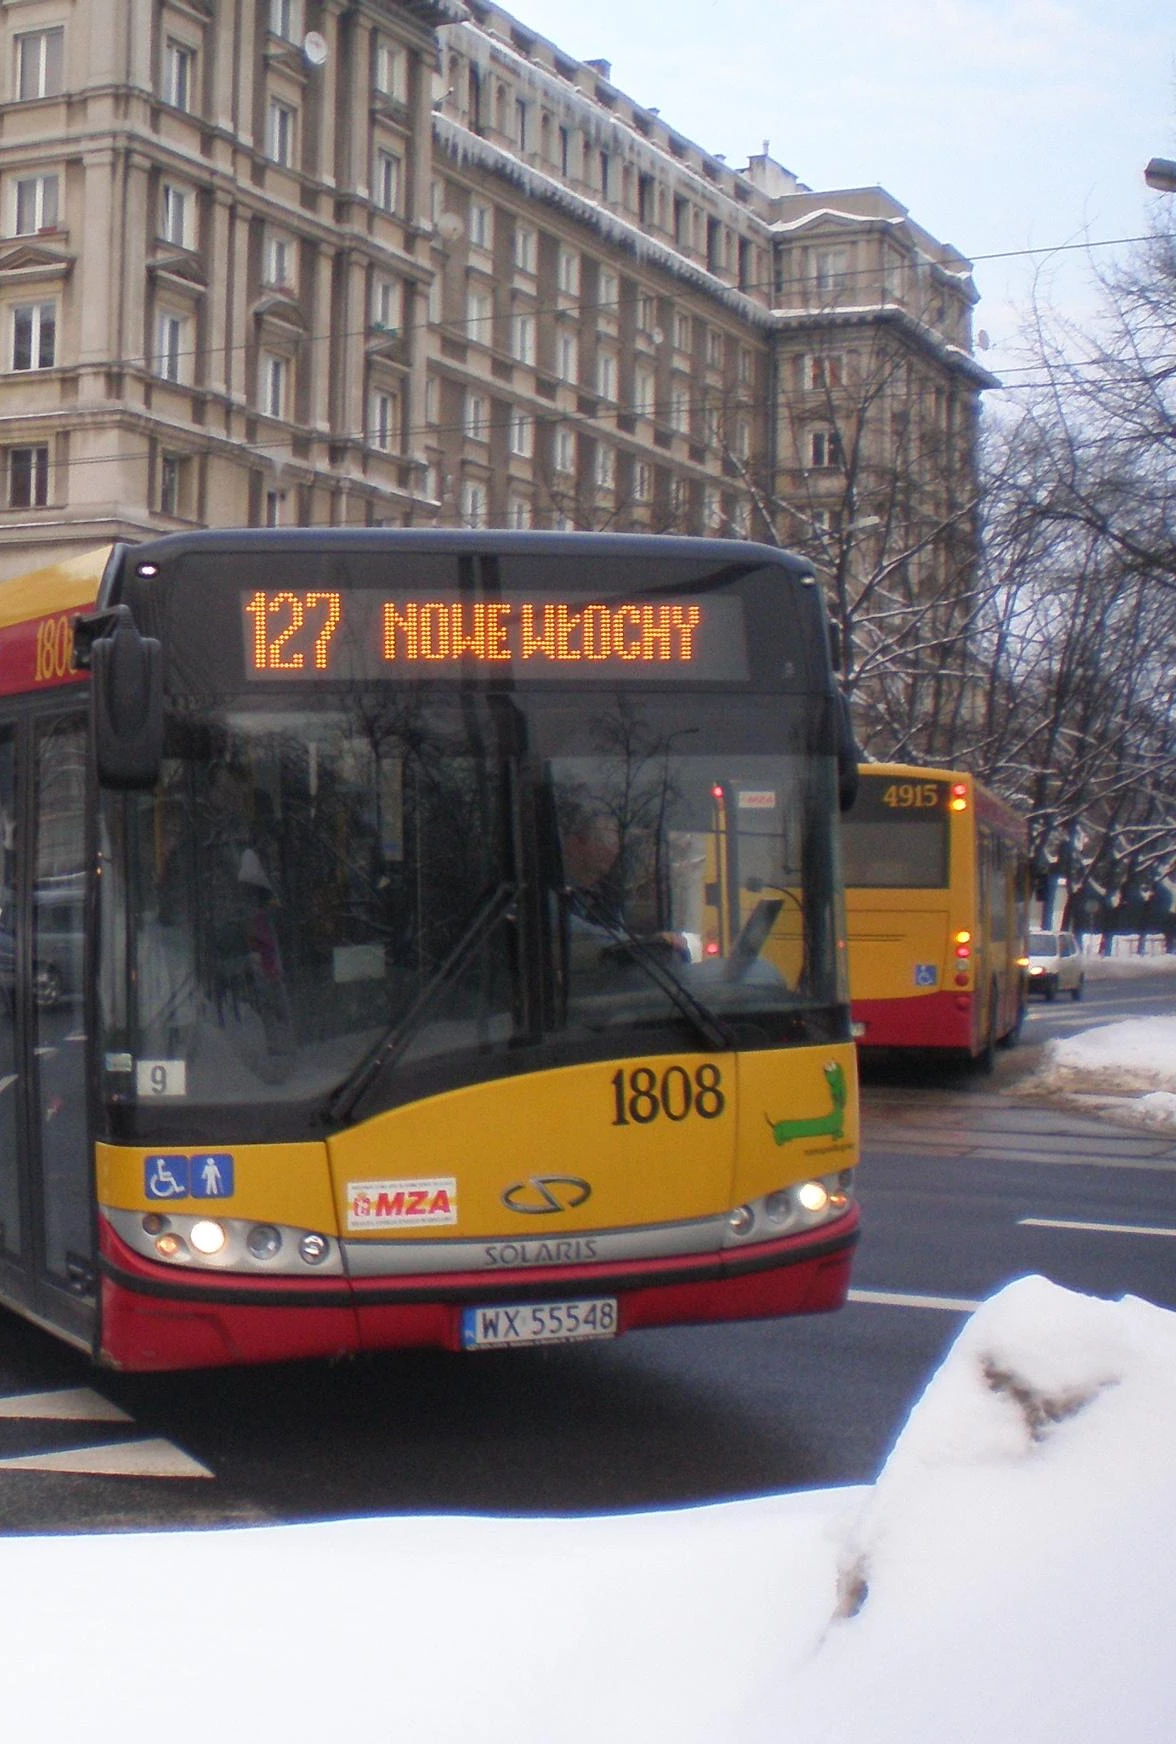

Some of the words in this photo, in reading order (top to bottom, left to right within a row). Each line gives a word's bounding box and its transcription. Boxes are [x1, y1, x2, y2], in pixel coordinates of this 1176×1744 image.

[245, 591, 342, 669] 127
[383, 602, 512, 660] NOWE
[521, 603, 701, 661] WŁOCHY
[882, 783, 938, 808] 4915
[151, 1065, 167, 1095] 9
[611, 1063, 726, 1126] 1808
[375, 1189, 451, 1217] MZA
[483, 1239, 598, 1266] SOLARIS
[481, 1309, 520, 1339] WX
[531, 1302, 614, 1336] 55548
